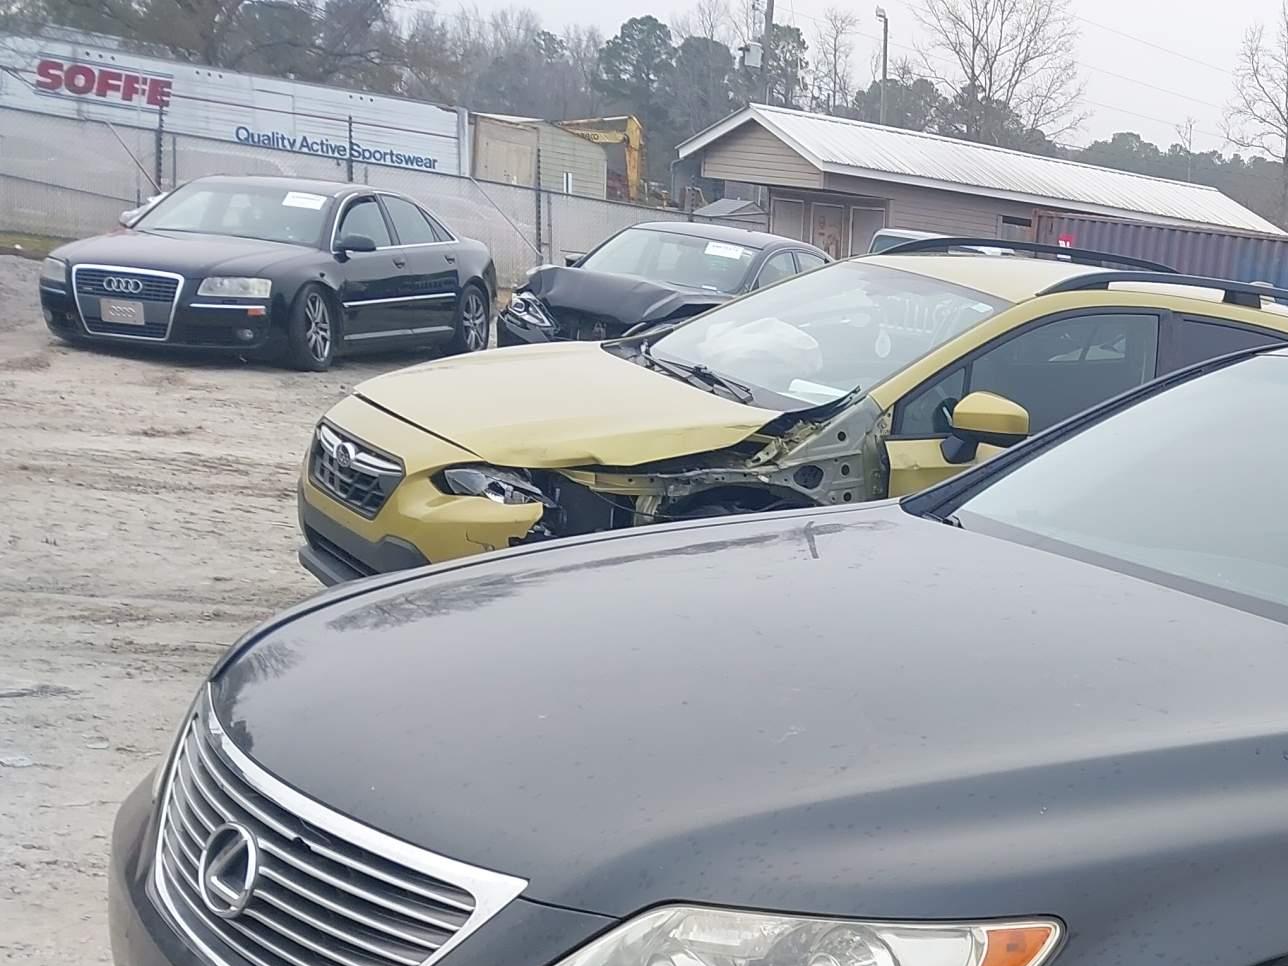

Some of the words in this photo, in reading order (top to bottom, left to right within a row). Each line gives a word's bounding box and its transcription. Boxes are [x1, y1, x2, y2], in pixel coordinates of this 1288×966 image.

[36, 59, 173, 108] SOFFE
[235, 126, 297, 150] Quality
[299, 136, 347, 157] Active
[350, 142, 438, 169] Sportswear
